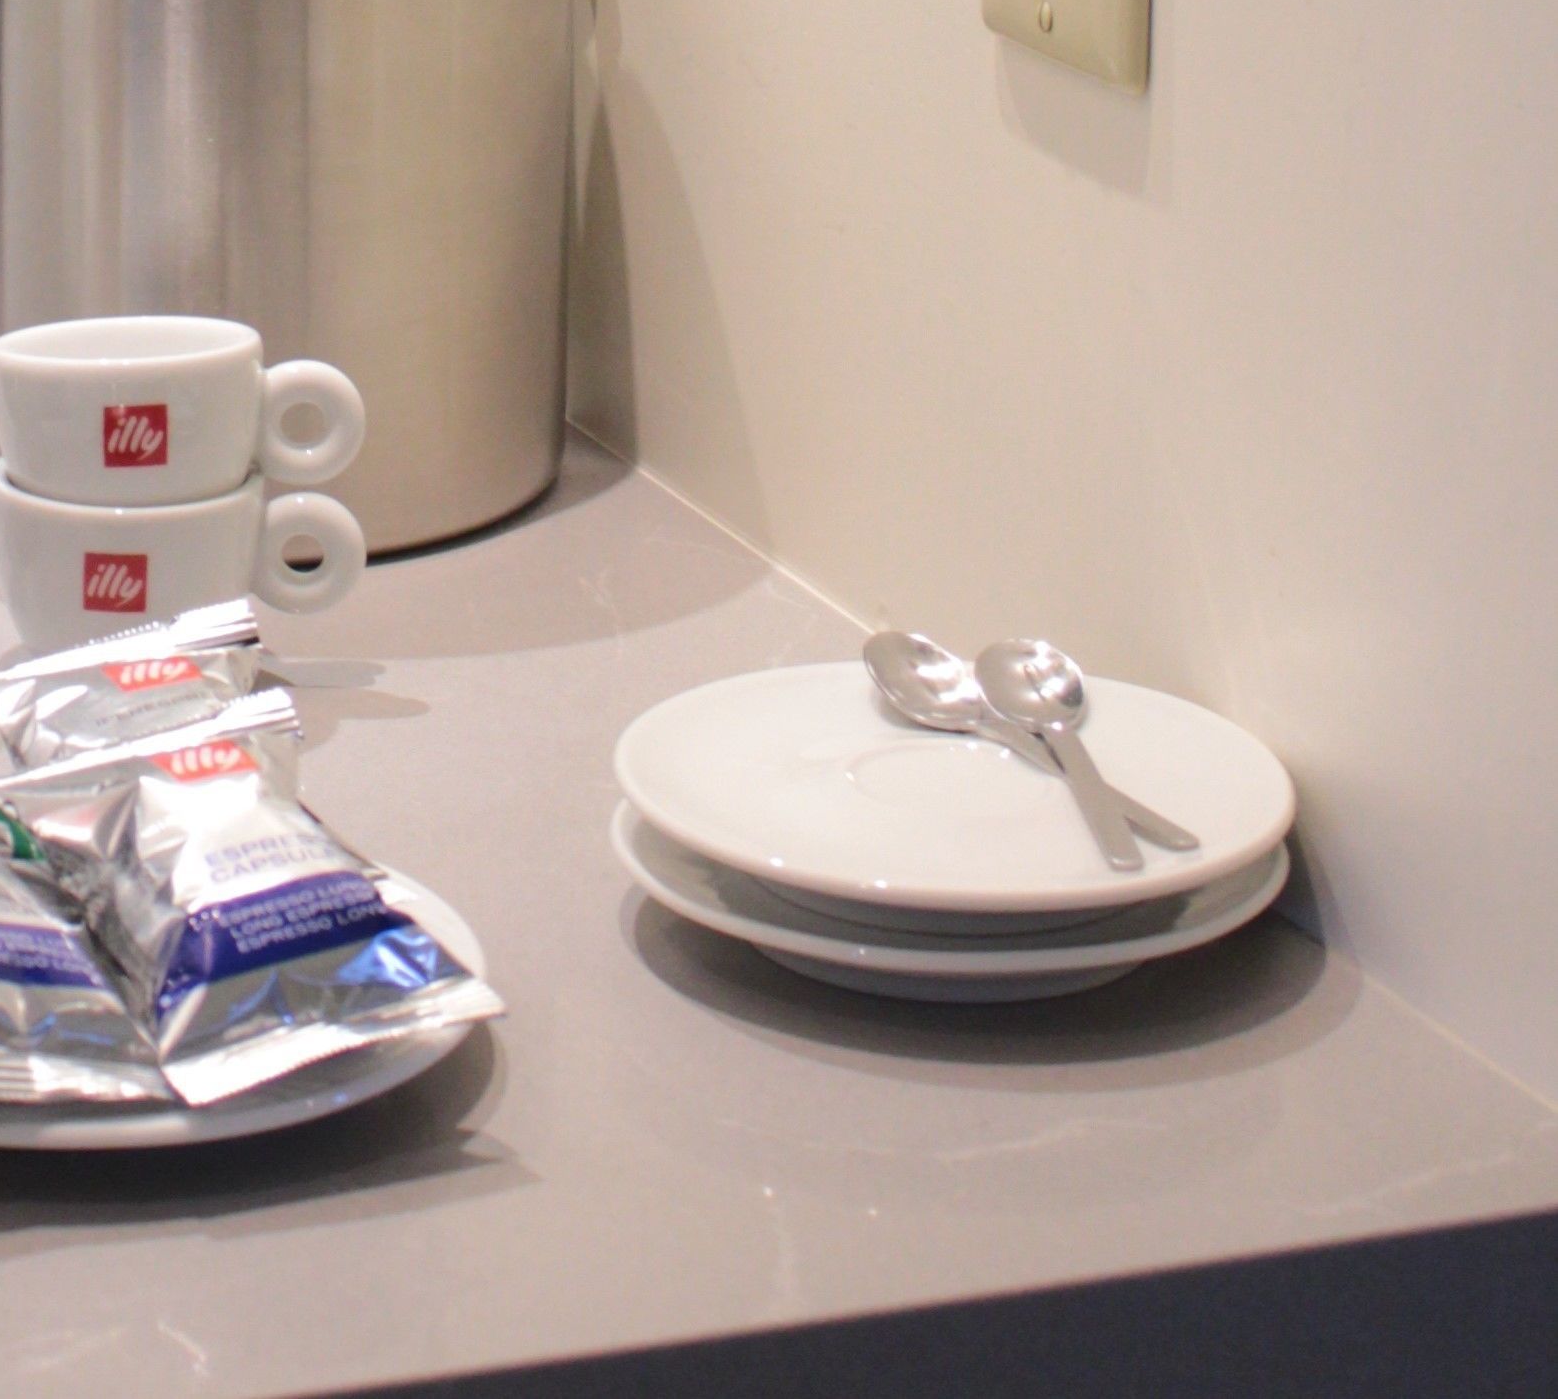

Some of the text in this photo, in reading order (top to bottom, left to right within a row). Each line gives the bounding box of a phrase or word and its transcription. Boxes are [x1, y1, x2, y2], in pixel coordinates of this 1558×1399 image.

[108, 415, 164, 462] illy
[87, 563, 142, 608] illy
[119, 660, 188, 685] illy
[171, 746, 241, 775] illy
